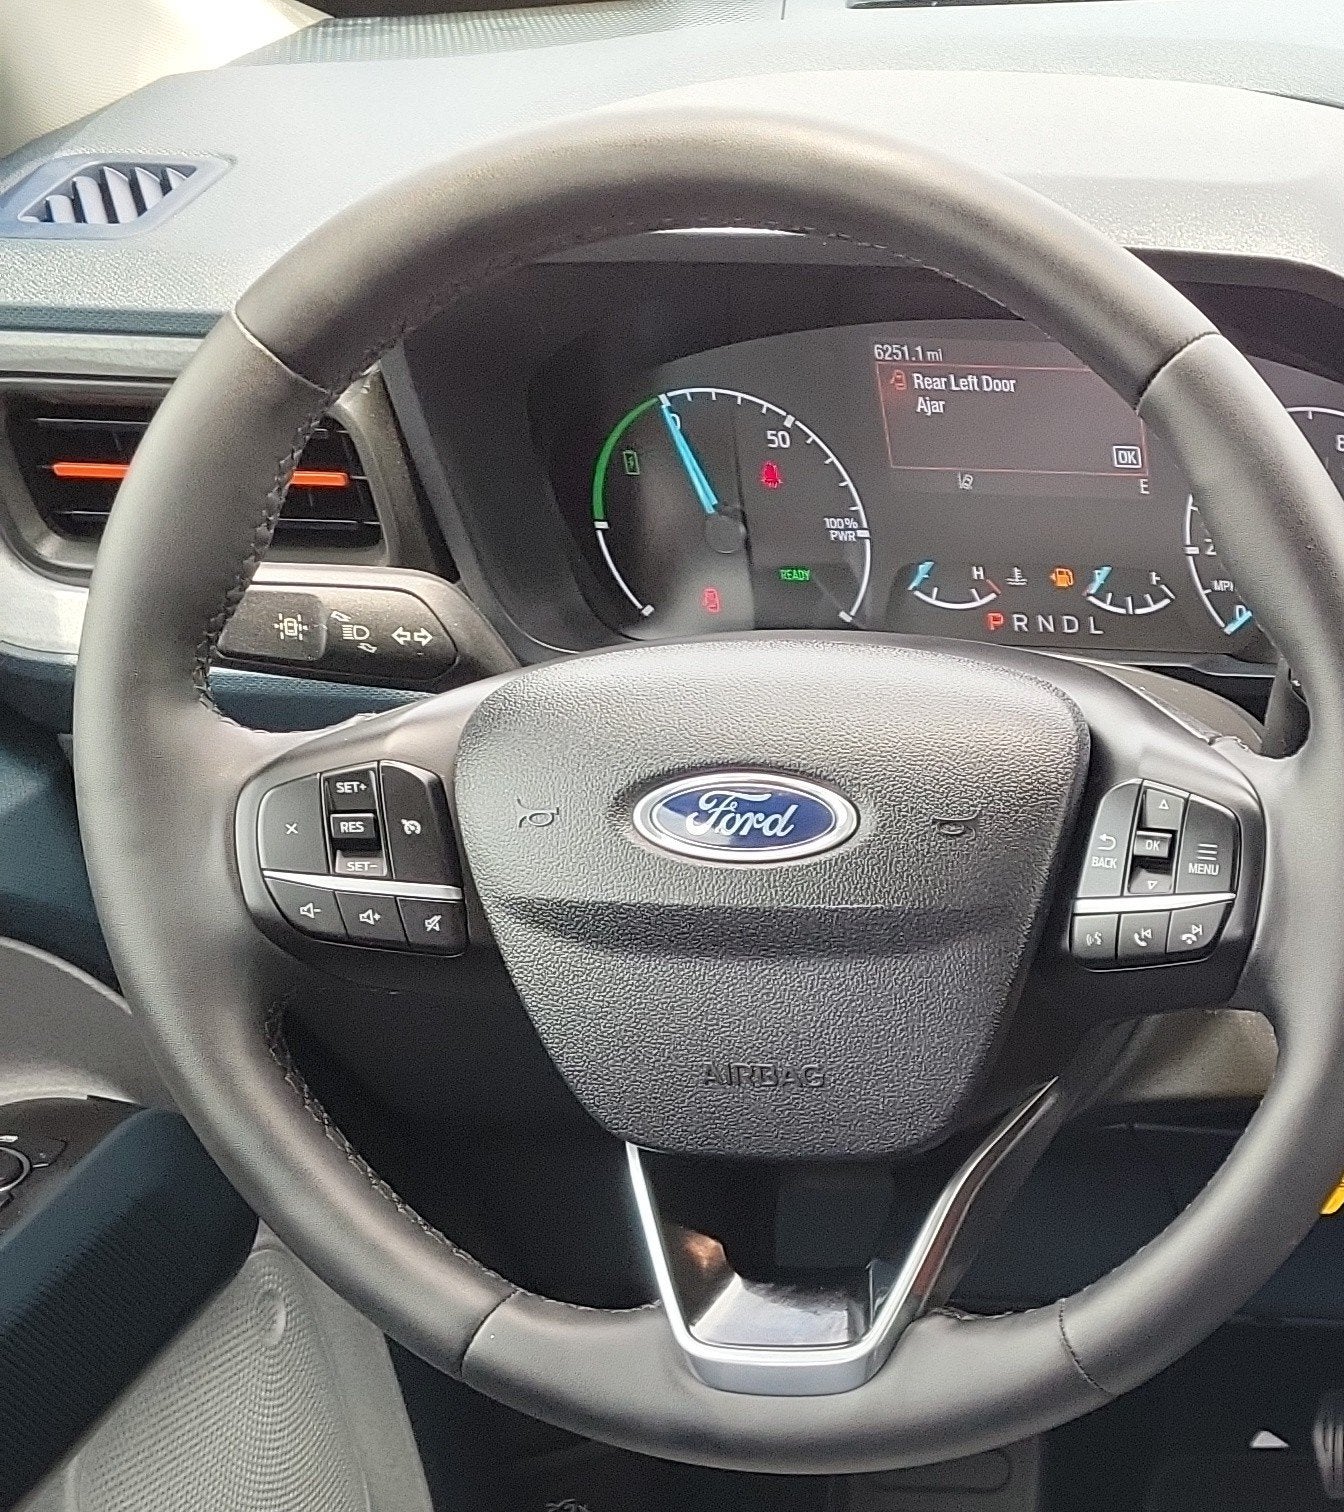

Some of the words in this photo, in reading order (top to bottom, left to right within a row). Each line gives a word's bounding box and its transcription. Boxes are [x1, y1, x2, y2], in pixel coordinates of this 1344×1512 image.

[874, 344, 923, 361] 6251.1
[927, 348, 943, 361] mi
[913, 373, 947, 390] Rear
[950, 374, 978, 391] Left
[982, 375, 1016, 393] Door
[916, 396, 945, 416] Ajar
[766, 430, 791, 448] 50
[1117, 450, 1137, 465] OK
[1139, 478, 1150, 494] E
[823, 517, 858, 529] 100%
[829, 530, 856, 541] PWR
[780, 569, 811, 580] READY
[971, 566, 985, 580] H
[987, 612, 1003, 630] P
[1012, 614, 1029, 632] R
[1036, 614, 1054, 633] N
[1063, 615, 1079, 634] D
[1090, 616, 1103, 635] L
[336, 781, 367, 793] SET+
[685, 790, 799, 837] Ford
[339, 821, 365, 833] RES
[1145, 840, 1160, 851] OK
[1091, 856, 1117, 869] BACK
[1188, 862, 1220, 876] MENU
[703, 1061, 825, 1088] AIRBAG
